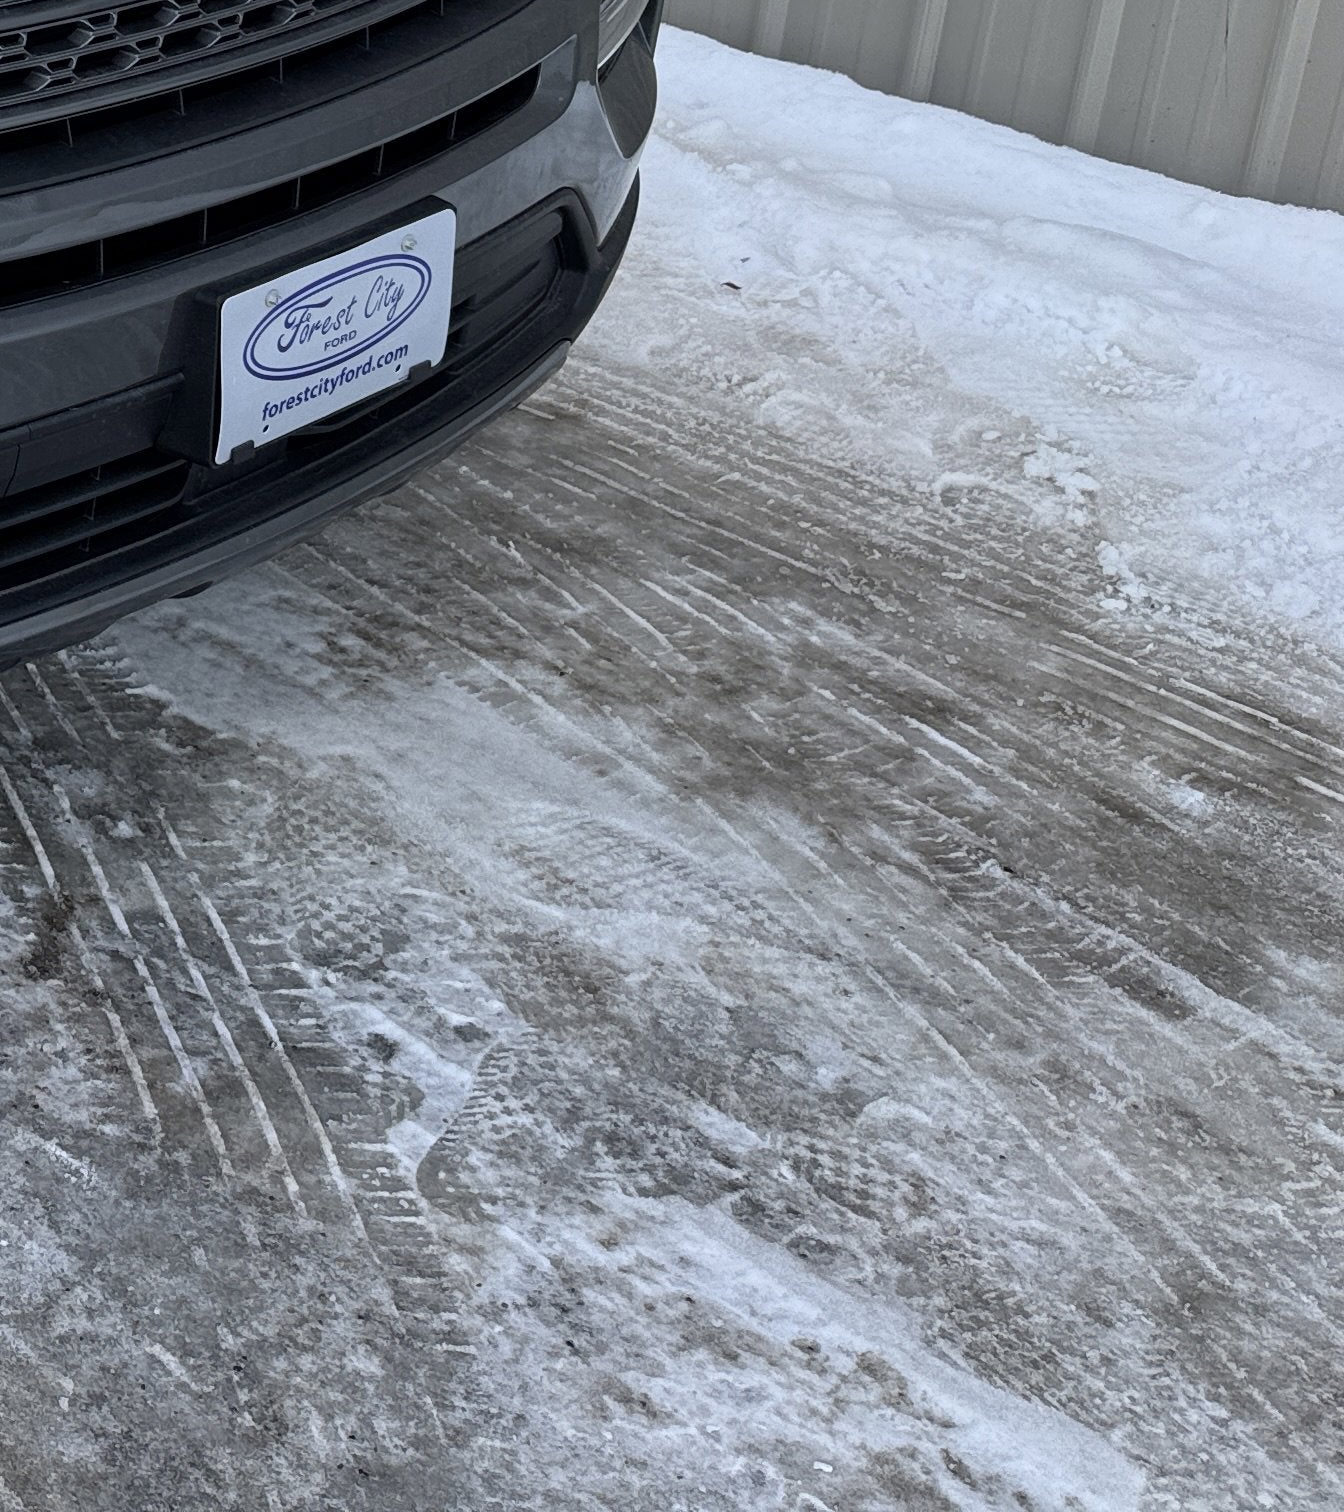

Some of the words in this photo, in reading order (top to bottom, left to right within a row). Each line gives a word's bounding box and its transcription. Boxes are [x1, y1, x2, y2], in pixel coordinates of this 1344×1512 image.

[276, 294, 358, 354] Forest
[364, 274, 405, 323] City
[323, 329, 358, 352] FORD
[261, 343, 409, 422] forestcityford.com
